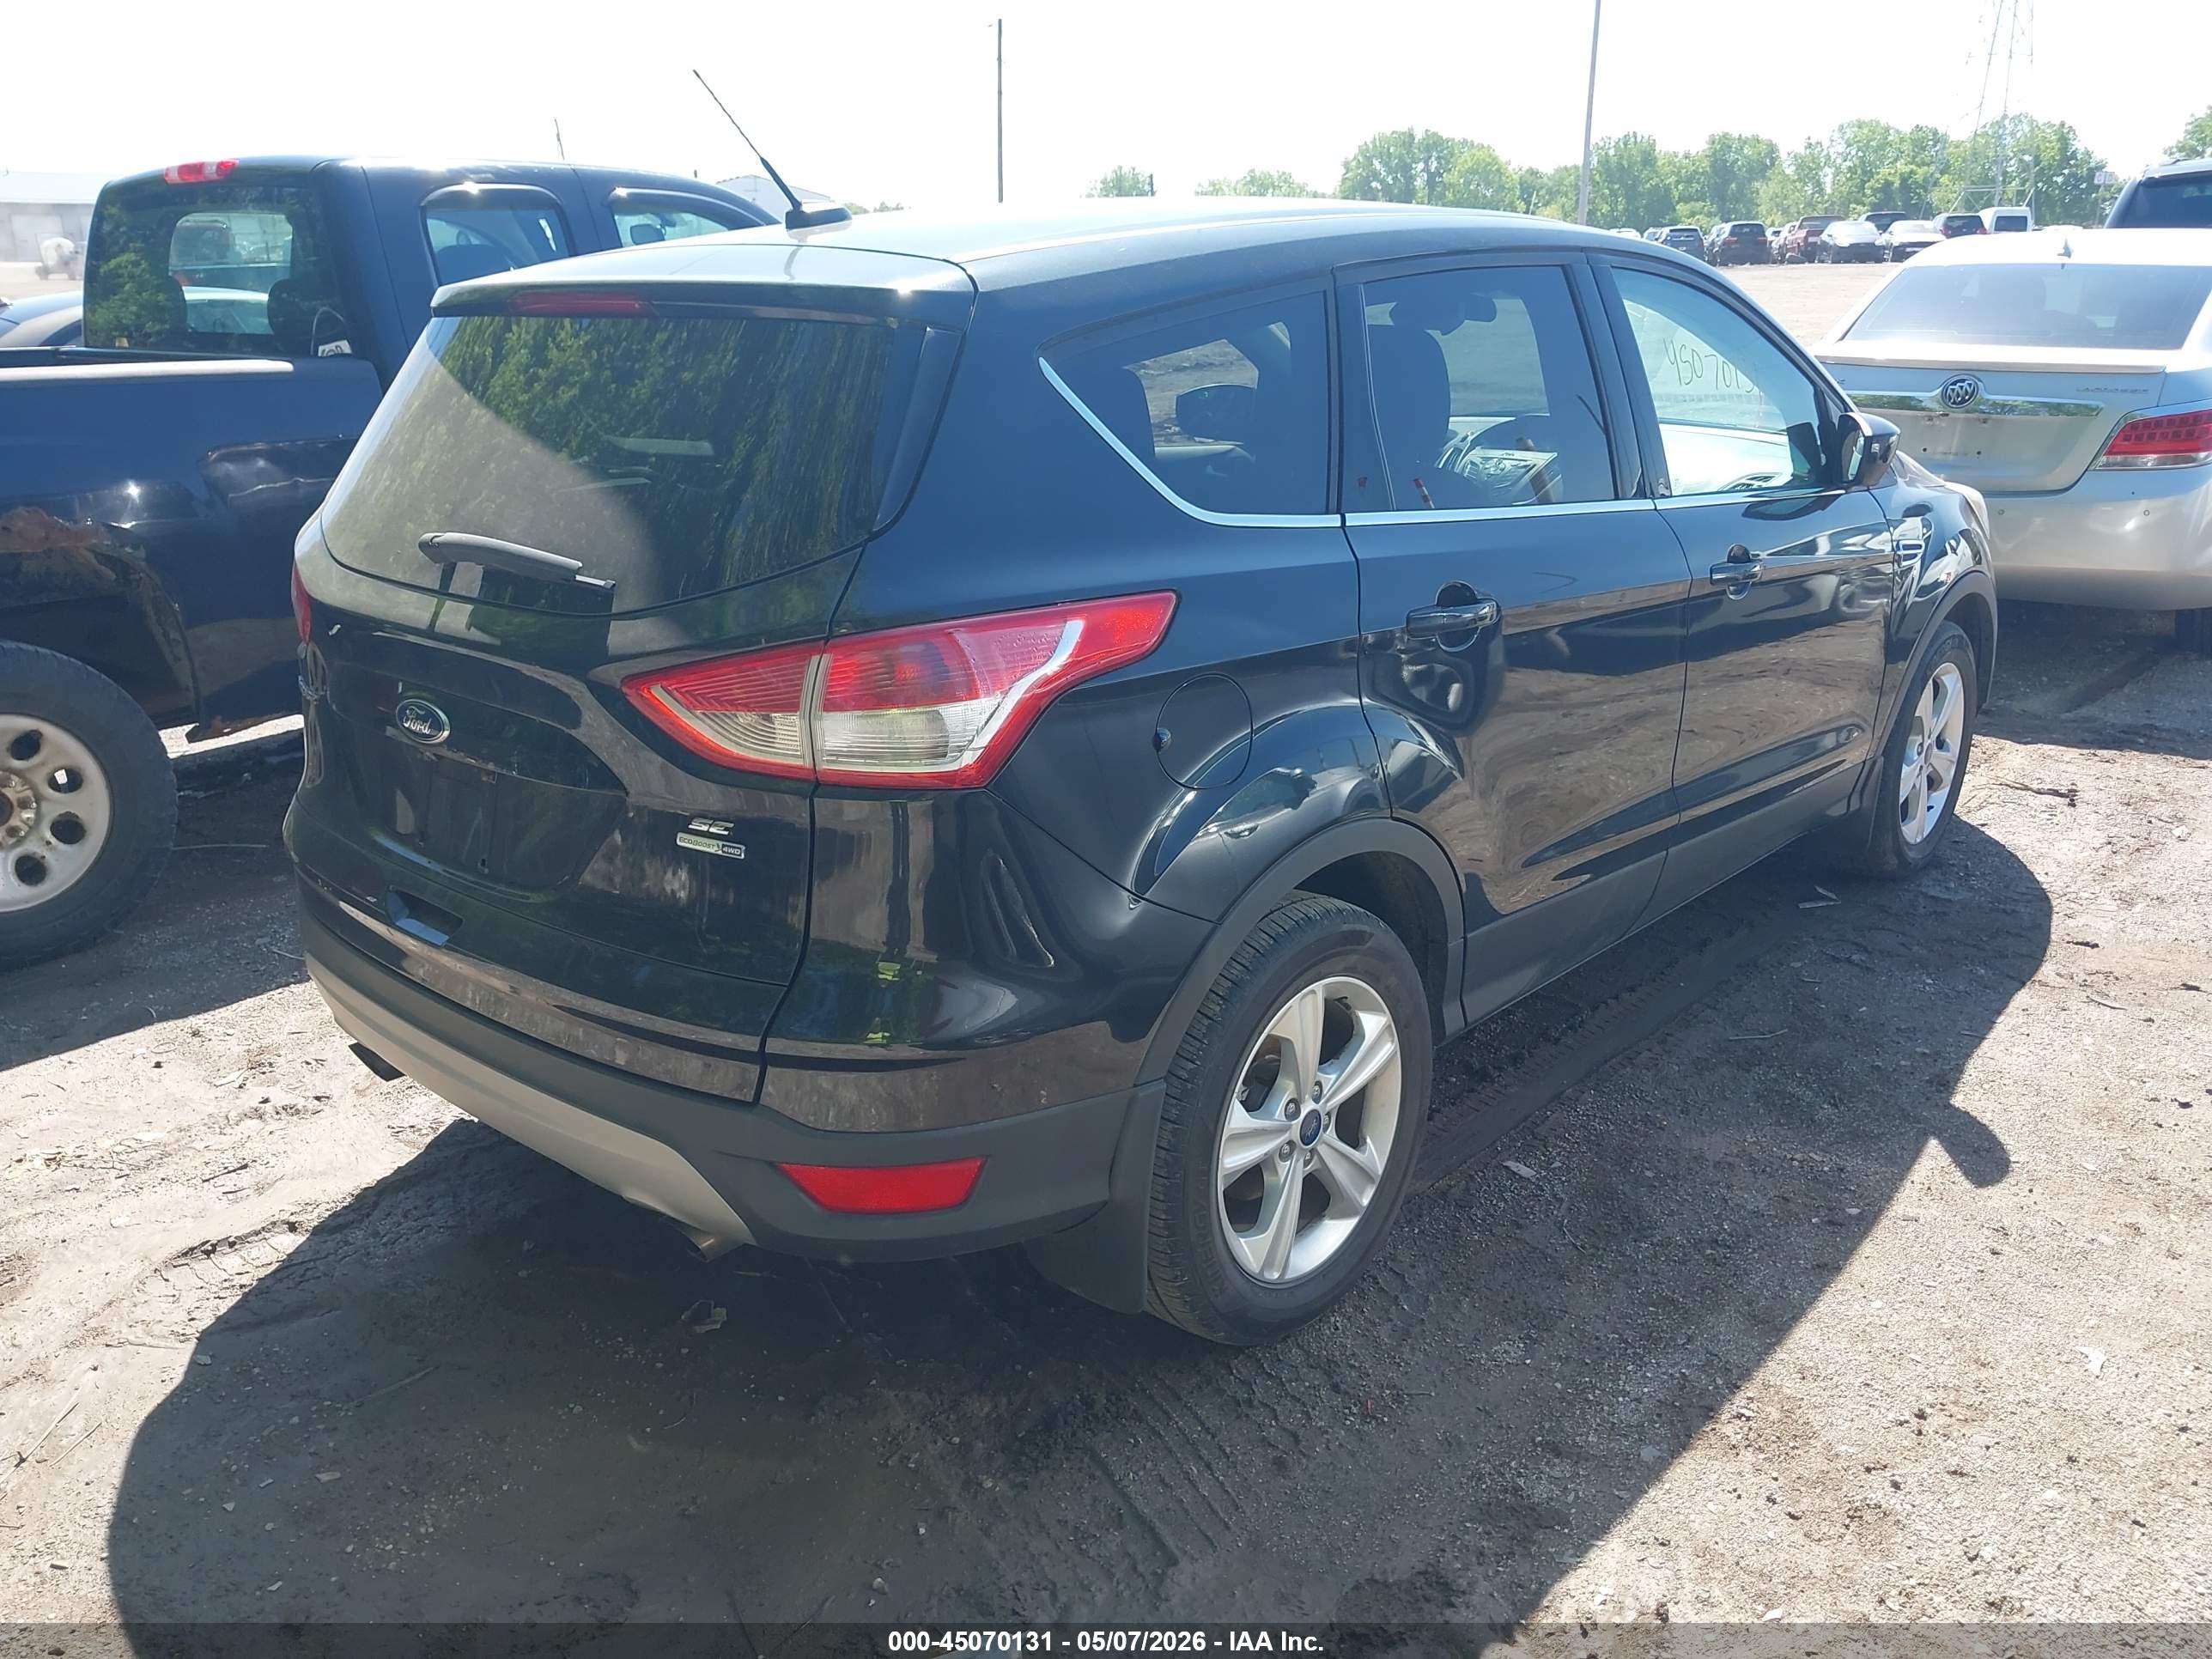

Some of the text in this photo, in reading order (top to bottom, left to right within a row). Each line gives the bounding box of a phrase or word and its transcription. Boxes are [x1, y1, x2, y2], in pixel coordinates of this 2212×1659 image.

[403, 706, 433, 734] Ford
[688, 817, 734, 835] SE
[722, 846, 741, 855] 4WD
